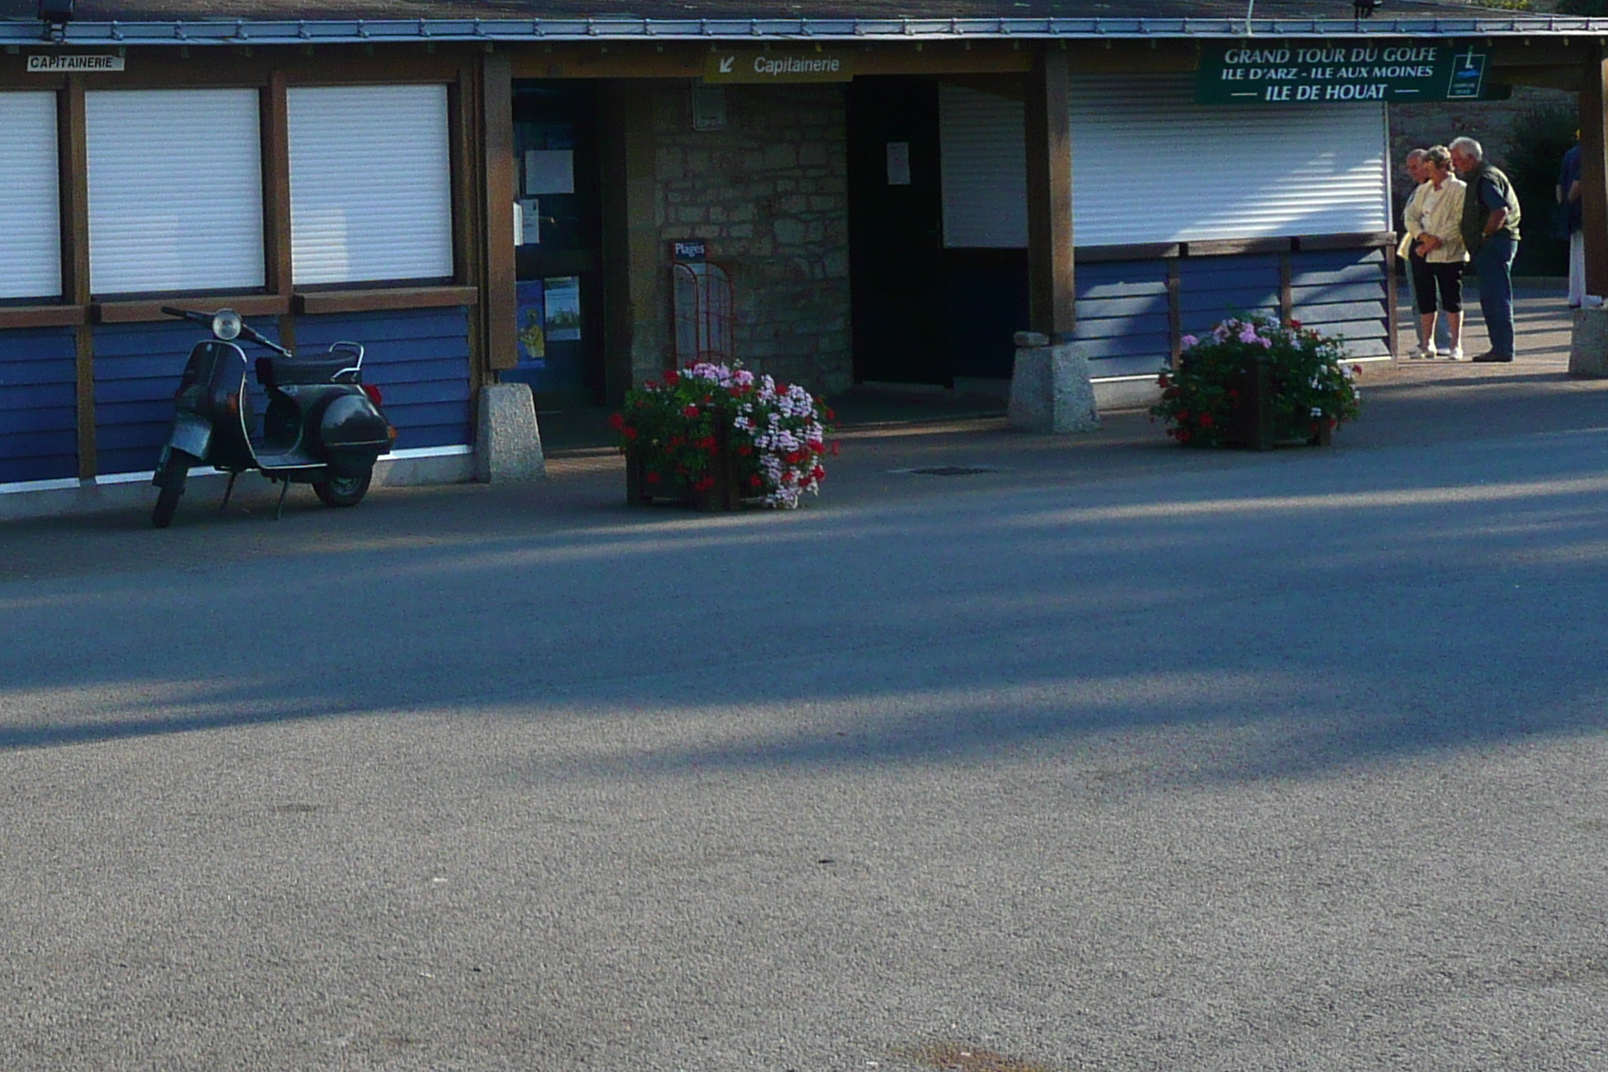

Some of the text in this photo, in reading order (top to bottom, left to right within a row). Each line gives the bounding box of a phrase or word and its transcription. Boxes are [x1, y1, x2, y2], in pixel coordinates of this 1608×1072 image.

[30, 56, 114, 69] CAPITAINERIE
[1225, 47, 1438, 64] GRAND TOUR DU GOLFE
[753, 56, 840, 75] Capitainerie
[1222, 68, 1244, 80] ILE
[1249, 67, 1298, 80] D'ARZ
[1311, 67, 1334, 79] ILE
[1338, 66, 1370, 78] AUX
[1372, 65, 1434, 78] MOINES
[1265, 84, 1388, 101] ILE DE HOUAT
